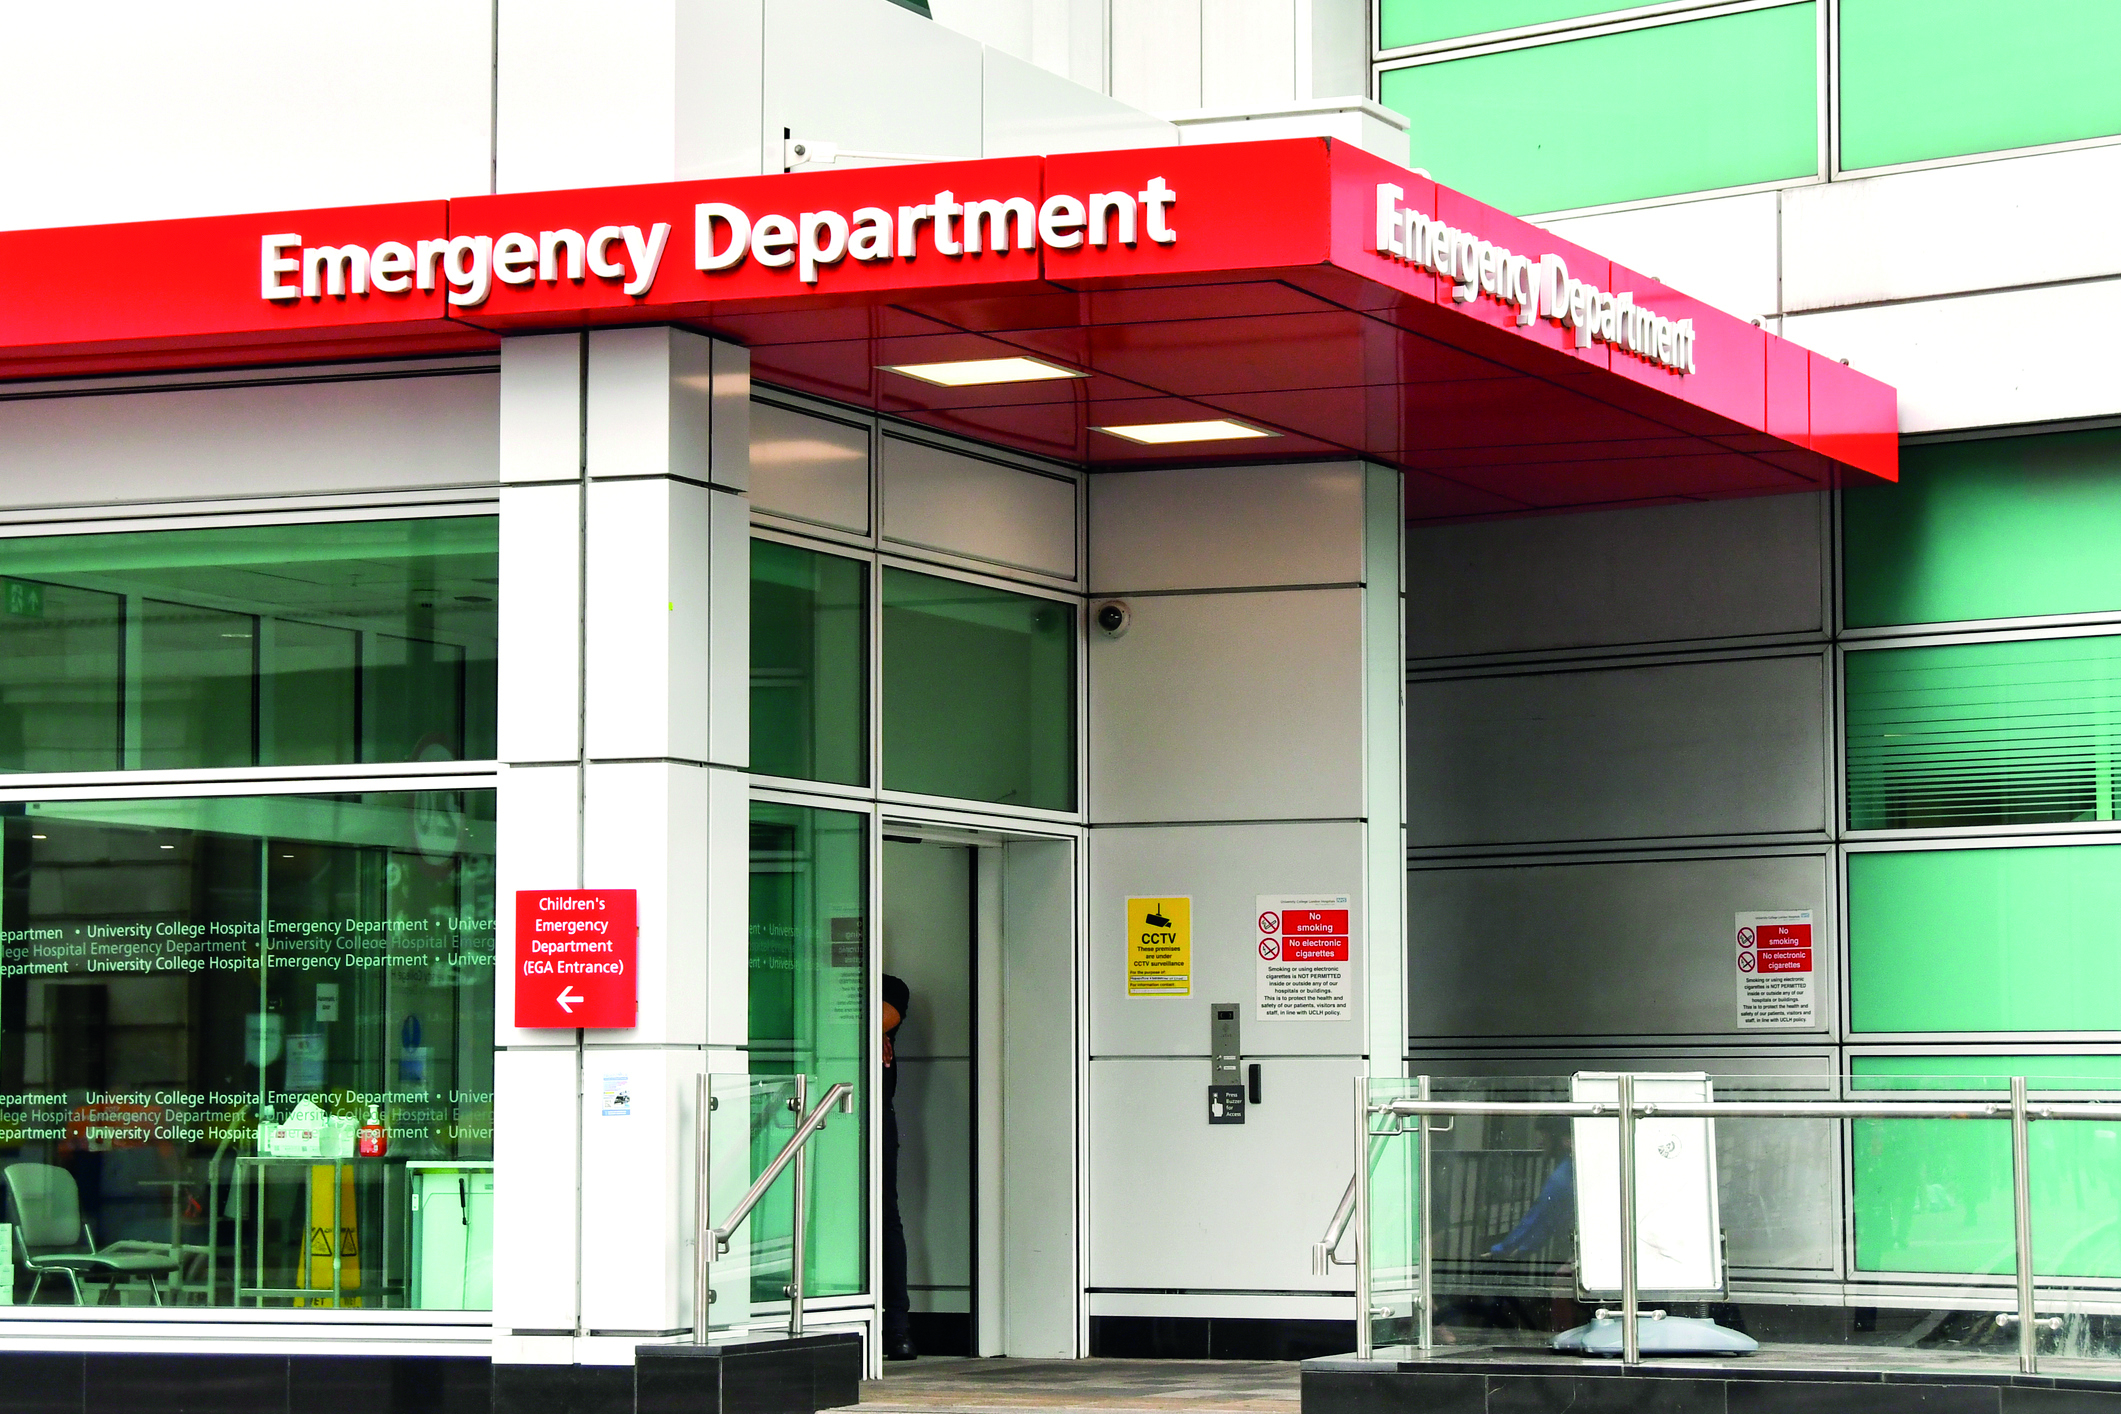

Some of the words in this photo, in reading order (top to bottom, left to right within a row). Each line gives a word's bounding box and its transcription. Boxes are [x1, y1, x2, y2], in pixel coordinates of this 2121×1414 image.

[261, 222, 671, 307] Emergency
[695, 176, 1177, 284] Department
[1377, 183, 1541, 326] Emergency
[1540, 253, 1696, 375] Department
[539, 896, 606, 910] Children's
[87, 923, 152, 938] University
[156, 922, 206, 938] College
[210, 920, 264, 936] Hospital
[268, 920, 342, 935] Emergency
[346, 918, 428, 934] Department
[536, 918, 608, 934] Emergency
[1297, 924, 1333, 933] smoking
[1142, 933, 1176, 944] CCTV
[1769, 937, 1798, 946] smoking
[34, 943, 86, 959] Hospital
[90, 942, 162, 958] Emergency
[166, 939, 246, 955] Department
[266, 937, 332, 954] University
[391, 935, 446, 952] Hospital
[532, 940, 613, 956] Department
[1296, 950, 1335, 959] cigarettes
[87, 958, 152, 973] University
[156, 956, 205, 972] College
[210, 955, 263, 971] Hospital
[268, 954, 342, 970] Emergency
[346, 953, 428, 969] Department
[524, 960, 554, 976] (EGA
[558, 959, 624, 976] Entrance)
[1768, 962, 1800, 970] cigarettes
[86, 1091, 152, 1108] University
[154, 1091, 204, 1107] College
[208, 1090, 263, 1106] Hospital
[268, 1090, 342, 1106] Emergency
[346, 1090, 430, 1106] Department
[32, 1108, 84, 1124] Hospital
[89, 1109, 162, 1125] Emergency
[165, 1108, 246, 1124] Department
[86, 1126, 151, 1142] University
[154, 1126, 204, 1142] College
